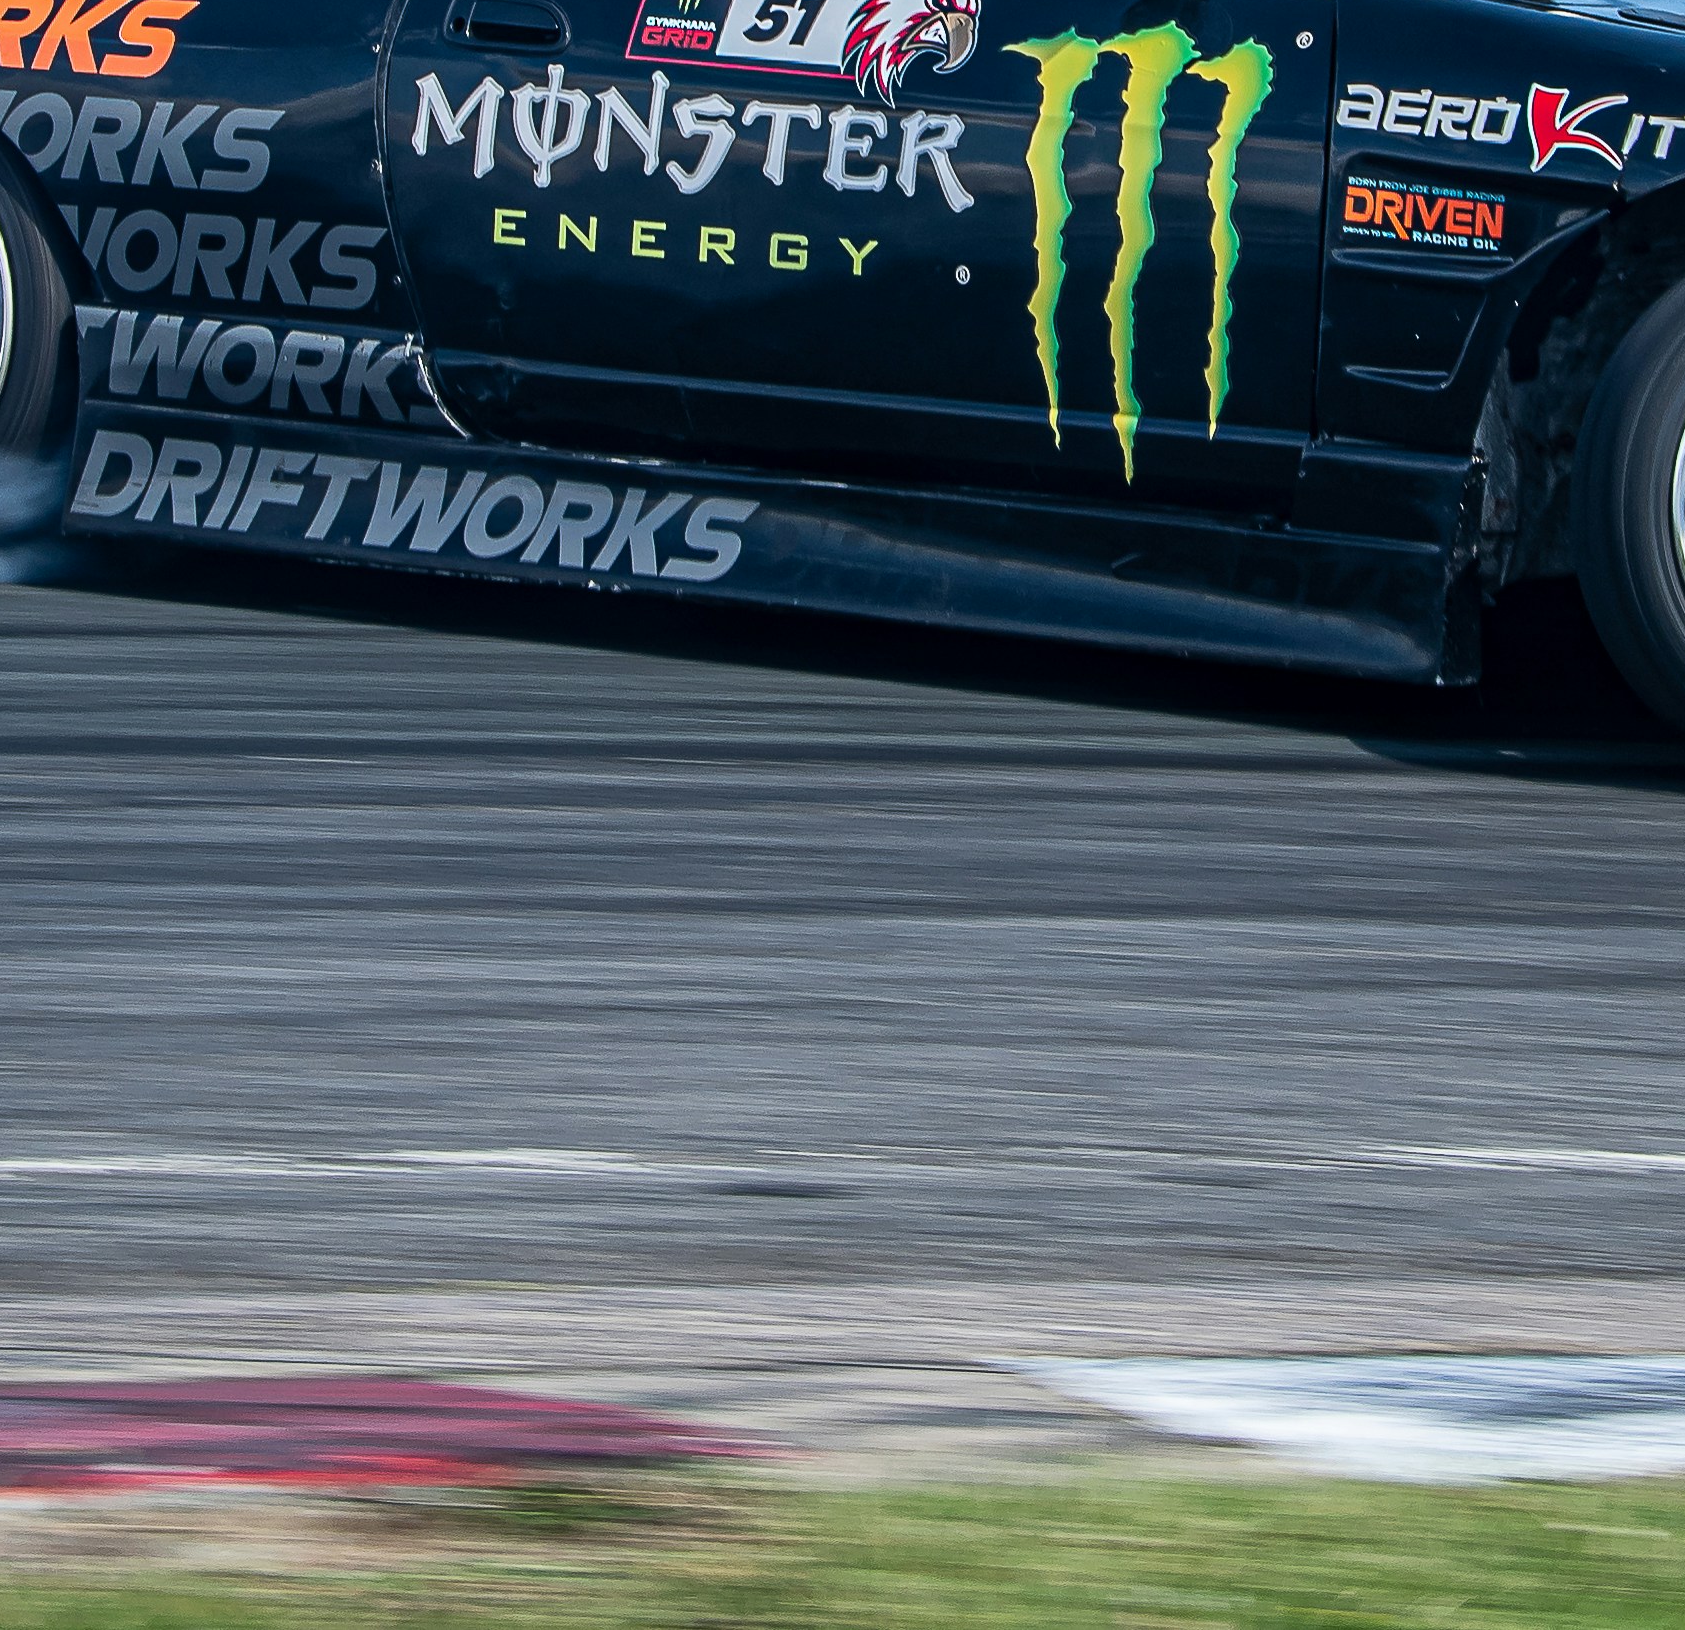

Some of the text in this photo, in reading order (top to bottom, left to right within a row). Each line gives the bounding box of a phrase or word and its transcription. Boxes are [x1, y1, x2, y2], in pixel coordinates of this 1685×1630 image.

[1344, 185, 1504, 241] DRIVEN
[1348, 176, 1377, 188] BORN
[1378, 179, 1407, 192] FROM
[1408, 183, 1430, 195] JOE
[1466, 190, 1506, 203] RACING
[494, 208, 880, 277] ENERGY
[1412, 230, 1499, 251] RACING OIL
[71, 429, 761, 582] DRIFTWORKS
